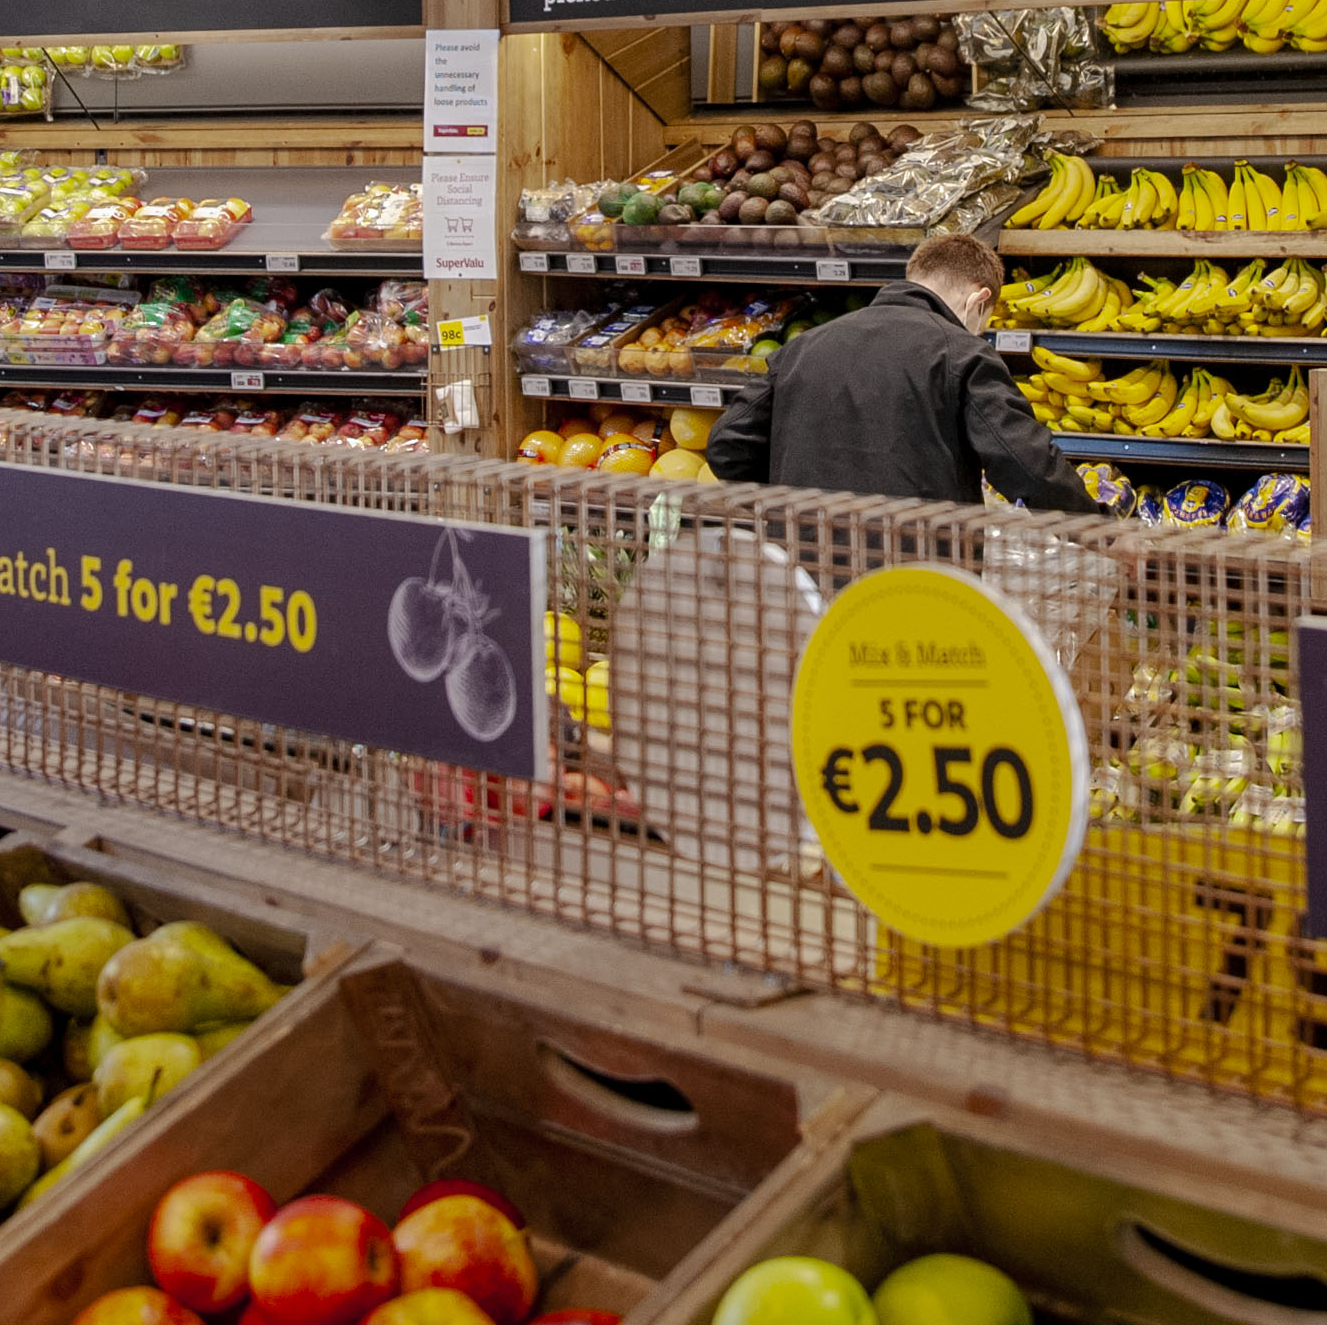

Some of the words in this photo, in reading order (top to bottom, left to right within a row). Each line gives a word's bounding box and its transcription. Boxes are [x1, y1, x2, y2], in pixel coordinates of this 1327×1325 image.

[435, 43, 458, 52] Please
[460, 43, 480, 52] avoid
[430, 172, 458, 183] Please
[446, 184, 473, 194] Social
[436, 195, 484, 208] Distancing
[436, 257, 485, 271] SuperValu
[441, 329, 462, 341] 98c
[80, 554, 103, 612] 5
[113, 558, 179, 626] for
[187, 574, 318, 653] €2.50
[880, 699, 895, 729] 5
[904, 699, 967, 732] FOR
[822, 743, 1035, 841] €2.50
